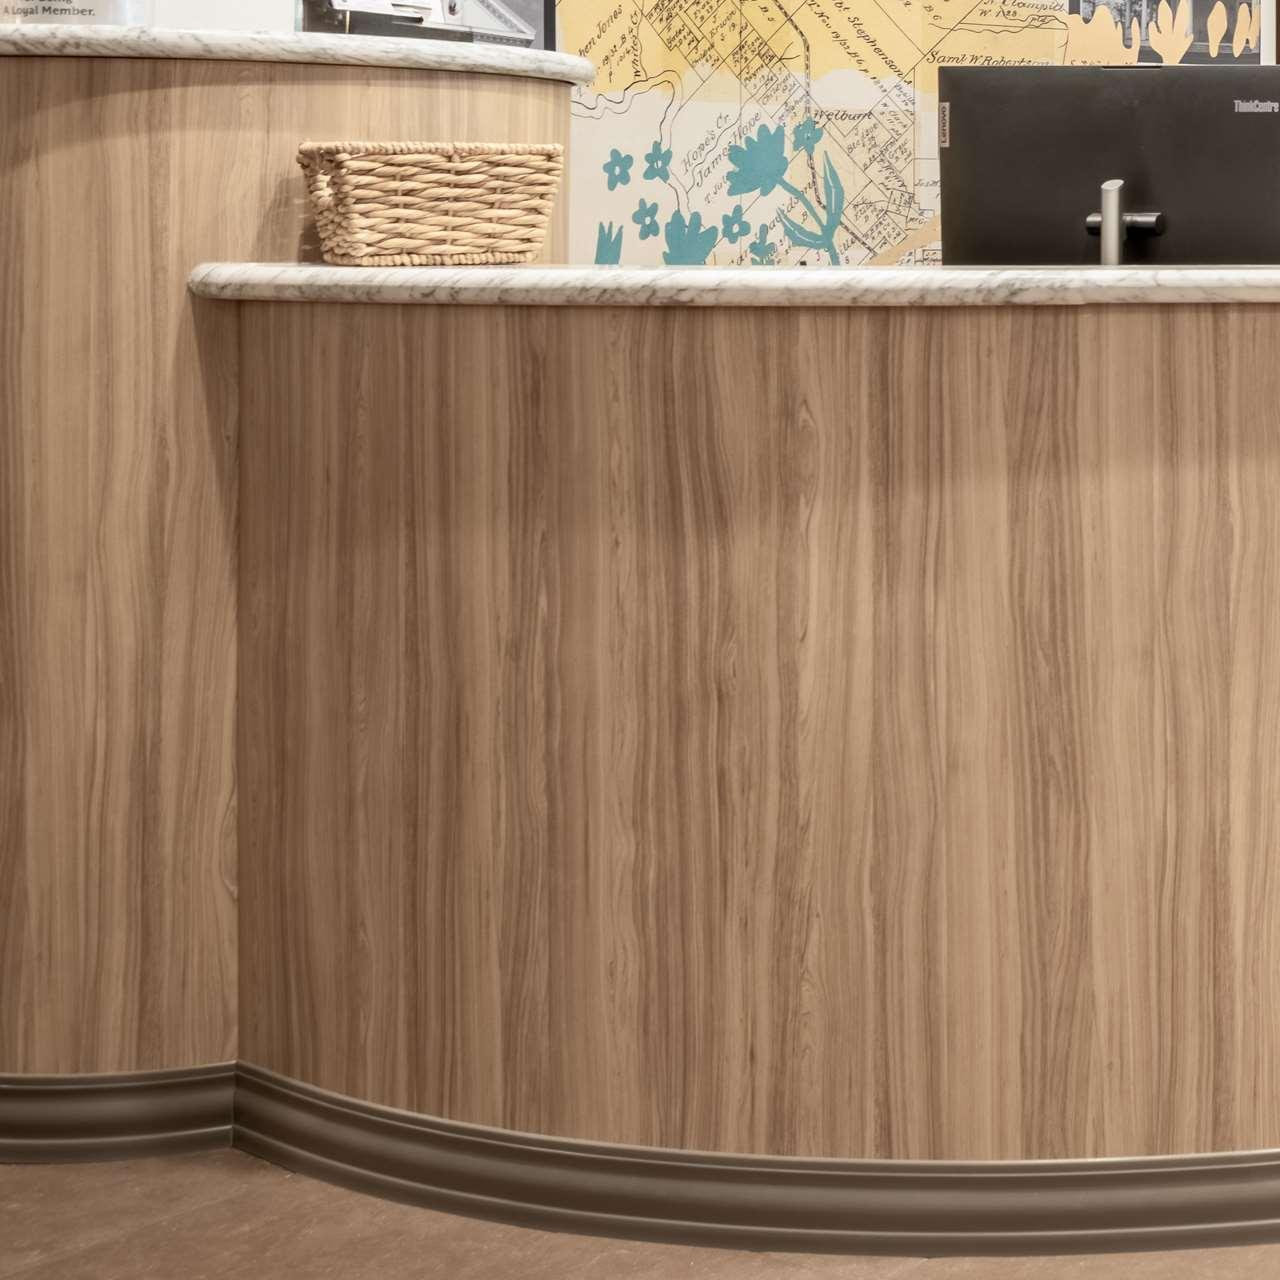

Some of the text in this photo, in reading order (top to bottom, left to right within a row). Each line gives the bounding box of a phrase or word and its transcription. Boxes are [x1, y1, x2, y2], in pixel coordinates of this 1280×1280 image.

[12, 6, 39, 17] Loyal
[41, 6, 96, 16] Member.
[1233, 99, 1280, 113] ThinkCentre
[940, 105, 949, 144] Lenovo
